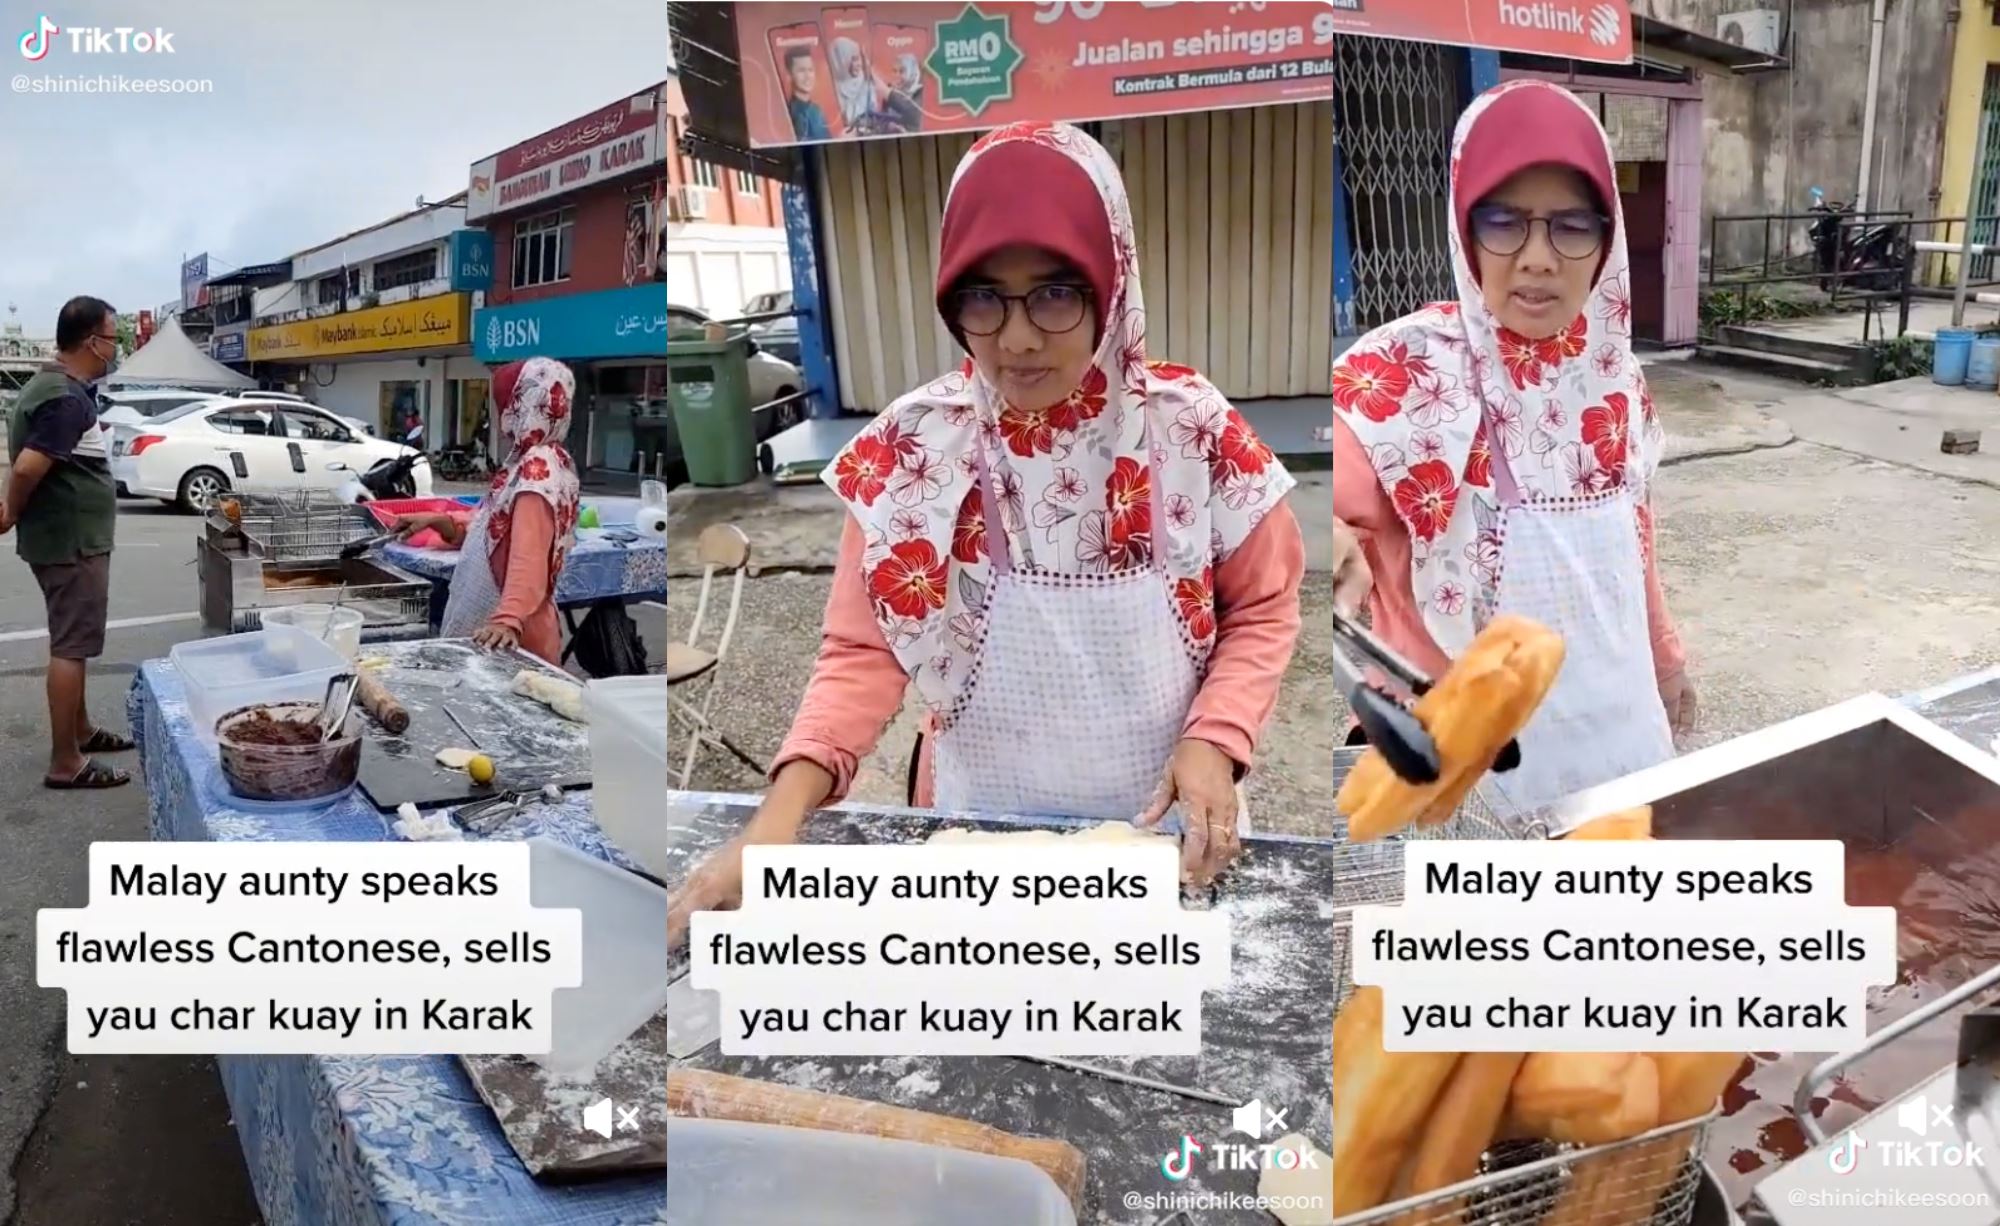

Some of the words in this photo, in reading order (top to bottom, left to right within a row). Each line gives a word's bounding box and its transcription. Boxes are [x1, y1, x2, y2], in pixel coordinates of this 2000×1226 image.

[1499, 0, 1585, 34] hotlink
[945, 31, 1001, 60] RM0
[1073, 38, 1165, 67] Jualan
[1172, 25, 1303, 55] sehingga
[1115, 75, 1175, 94] Kontrak
[1178, 69, 1243, 88] Bermula
[1246, 63, 1277, 80] dari
[1279, 63, 1299, 77] 12
[599, 134, 646, 173] KARAK
[462, 263, 490, 278] BSN
[320, 320, 358, 345] Maybank
[503, 317, 541, 347] BSN
